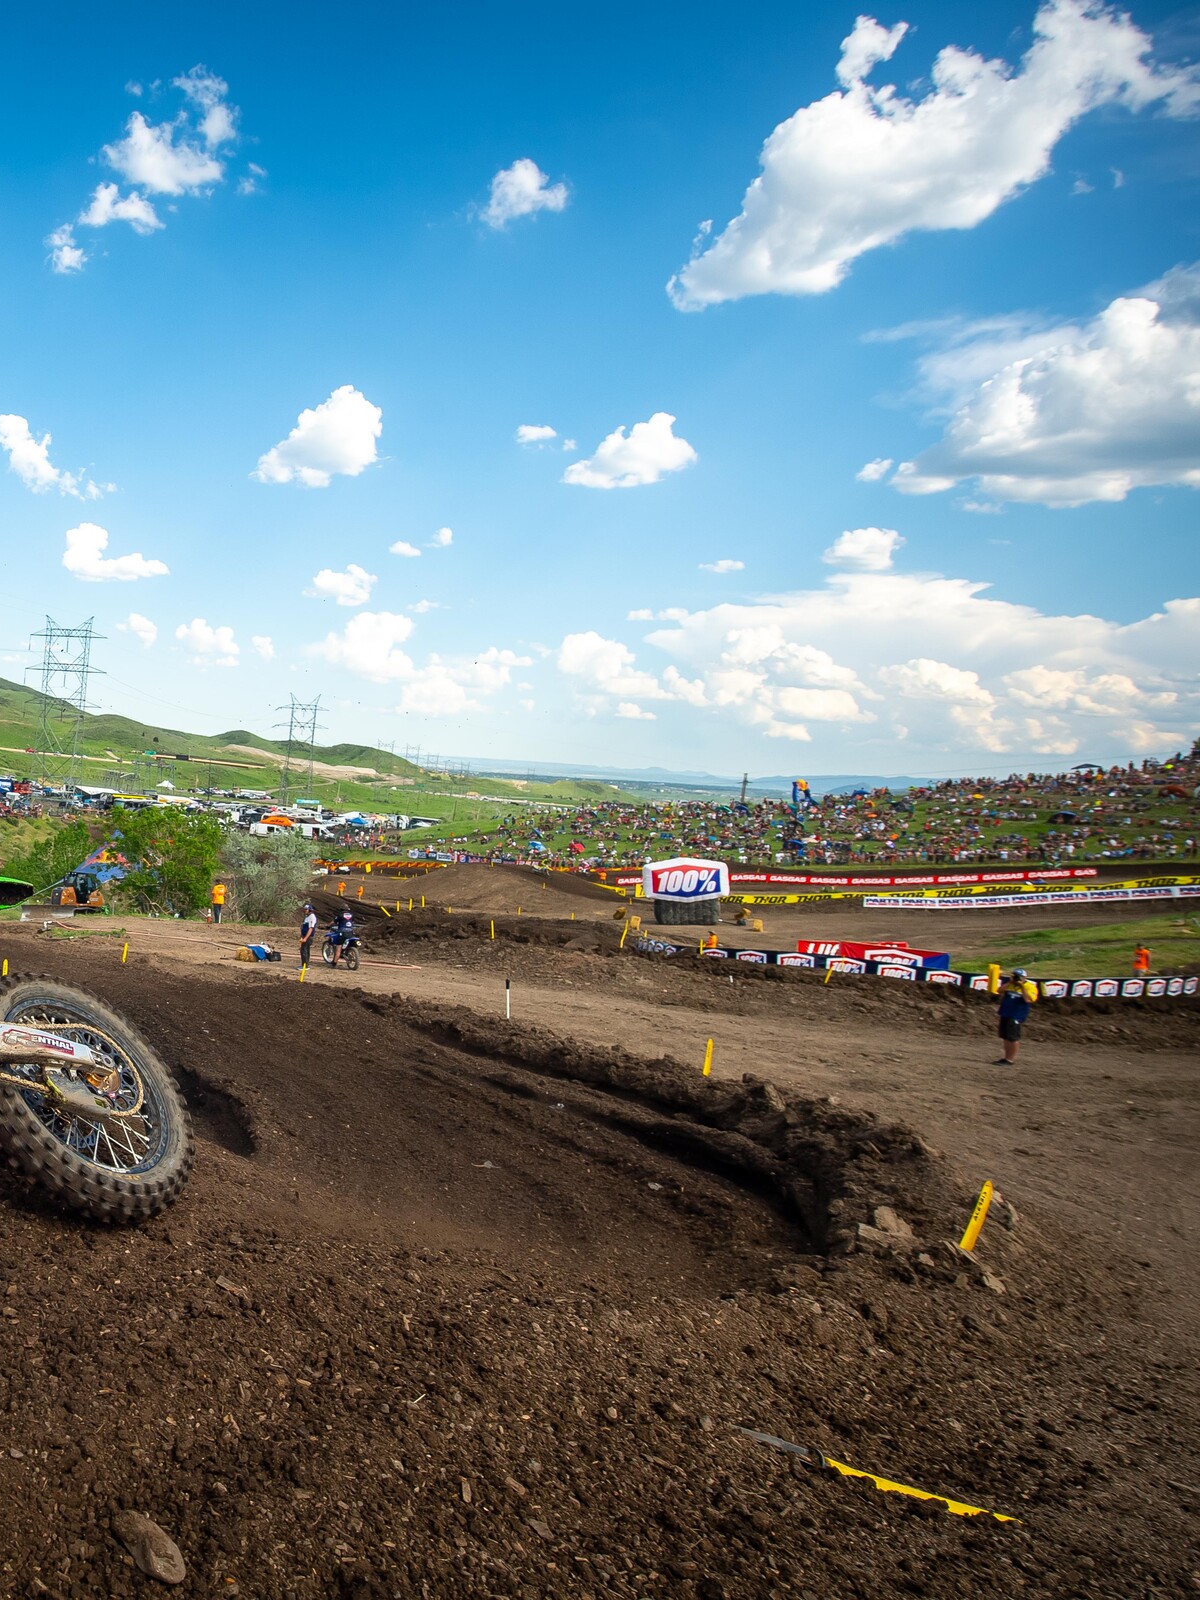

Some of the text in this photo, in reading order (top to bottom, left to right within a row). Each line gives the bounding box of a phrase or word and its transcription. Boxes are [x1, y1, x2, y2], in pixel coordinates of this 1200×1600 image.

[657, 869, 717, 893] 100%
[754, 896, 788, 904] THOR
[936, 888, 974, 896] THOR
[1135, 878, 1178, 888] THOR
[782, 957, 810, 967] 100%
[831, 961, 860, 973] 100%
[883, 968, 911, 979] 100%
